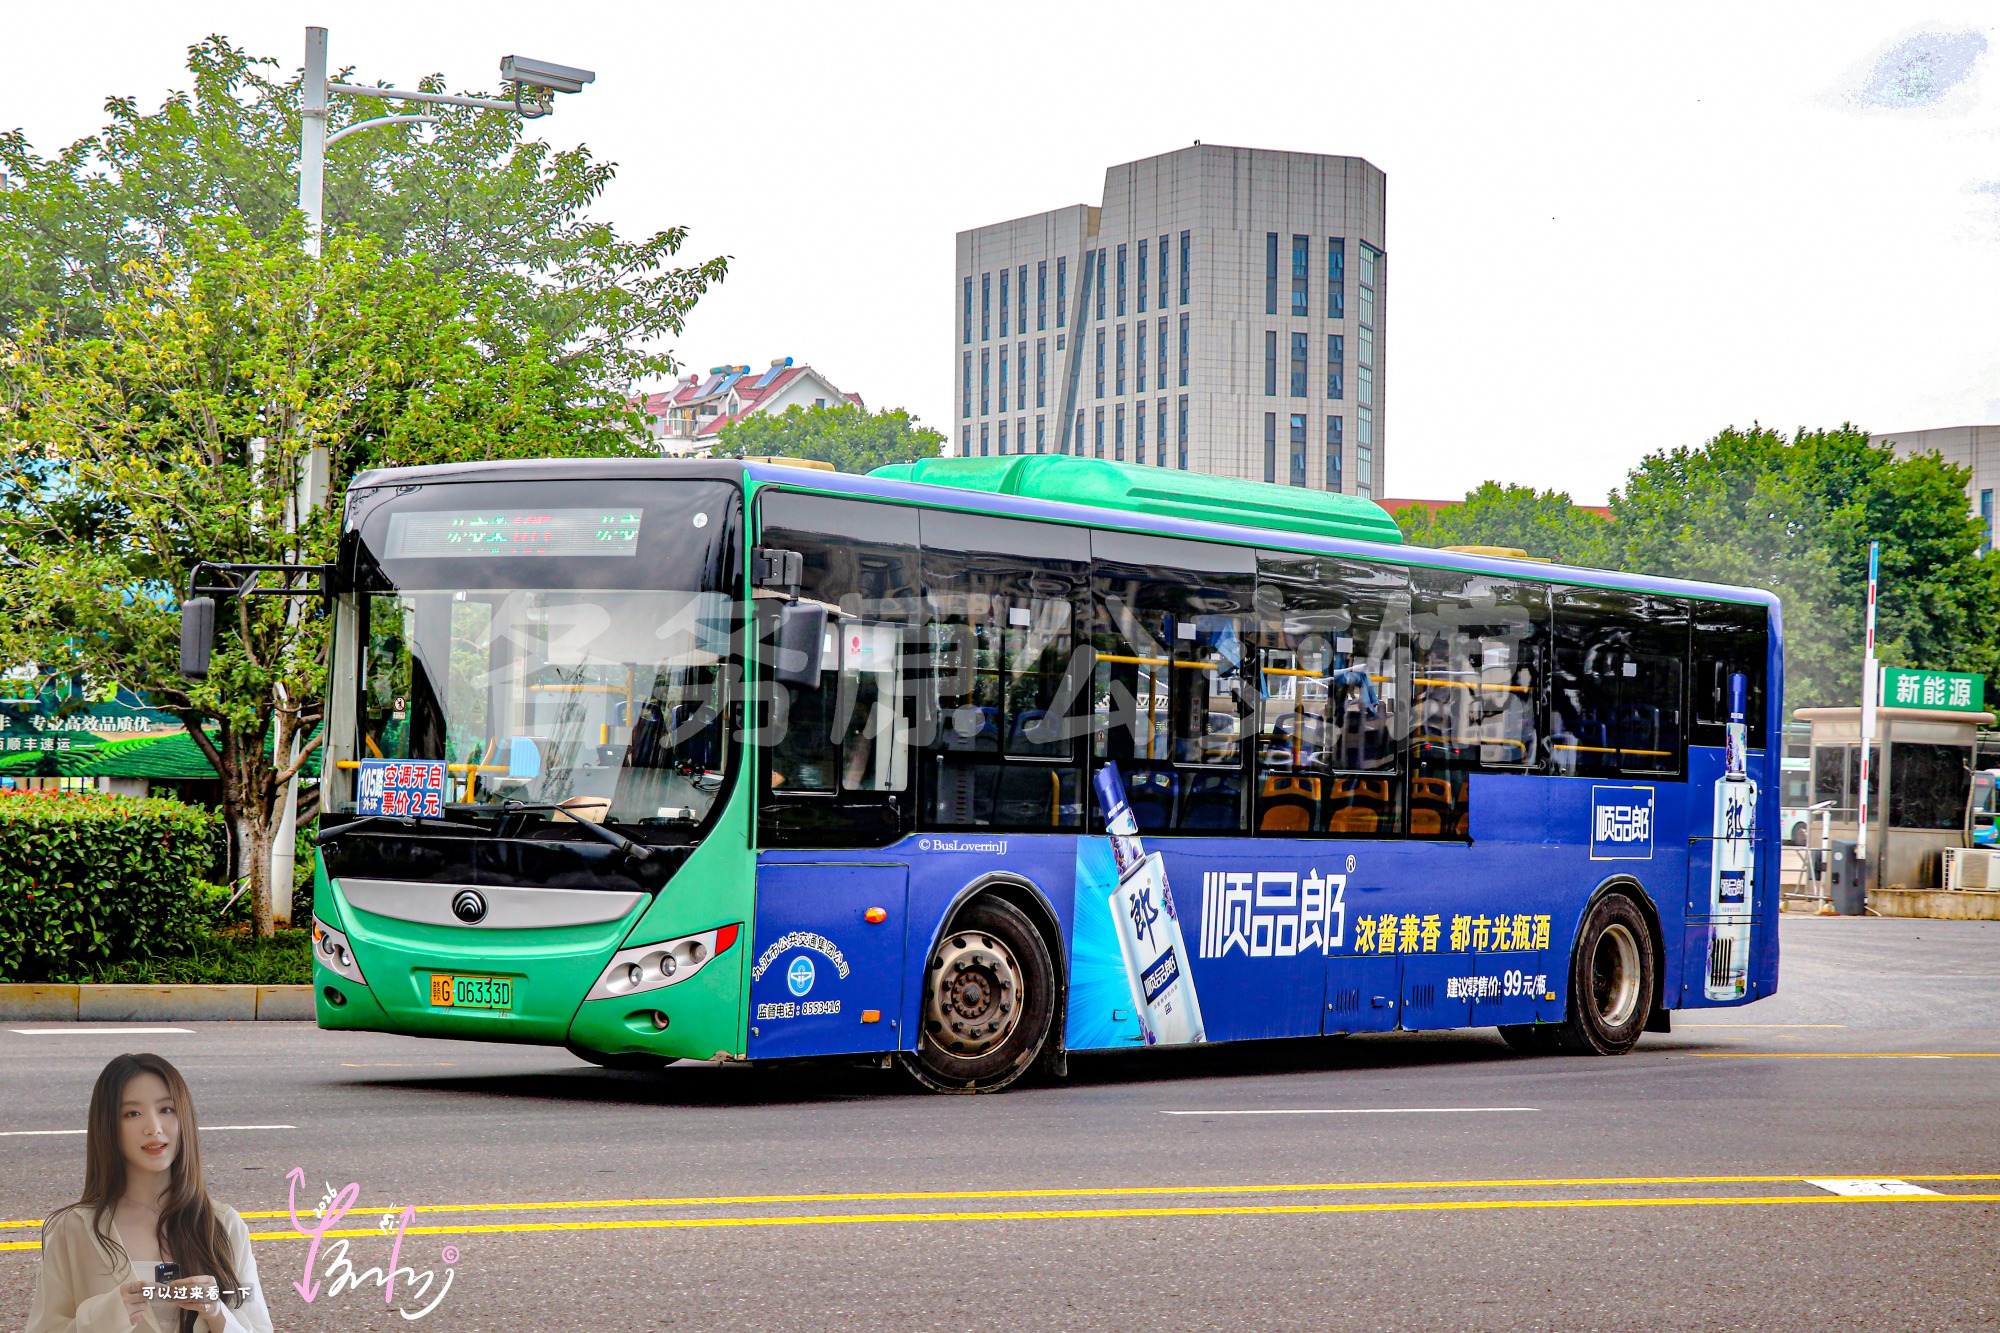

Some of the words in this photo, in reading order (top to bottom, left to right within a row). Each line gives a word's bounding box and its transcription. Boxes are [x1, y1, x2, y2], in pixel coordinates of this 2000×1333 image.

[1896, 673, 1972, 707] 新能源
[361, 767, 384, 798] 105路
[384, 764, 442, 789] 空调开启
[381, 791, 439, 816] 票价2元
[1596, 805, 1649, 842] 顺品郎
[1199, 867, 1347, 958] 顺品郎
[1354, 913, 1442, 953] 浓酱兼香
[1449, 913, 1551, 952] 都市光瓶酒
[752, 931, 850, 982] 九江市公共交通集团公司
[1144, 955, 1176, 997] 顺品郎
